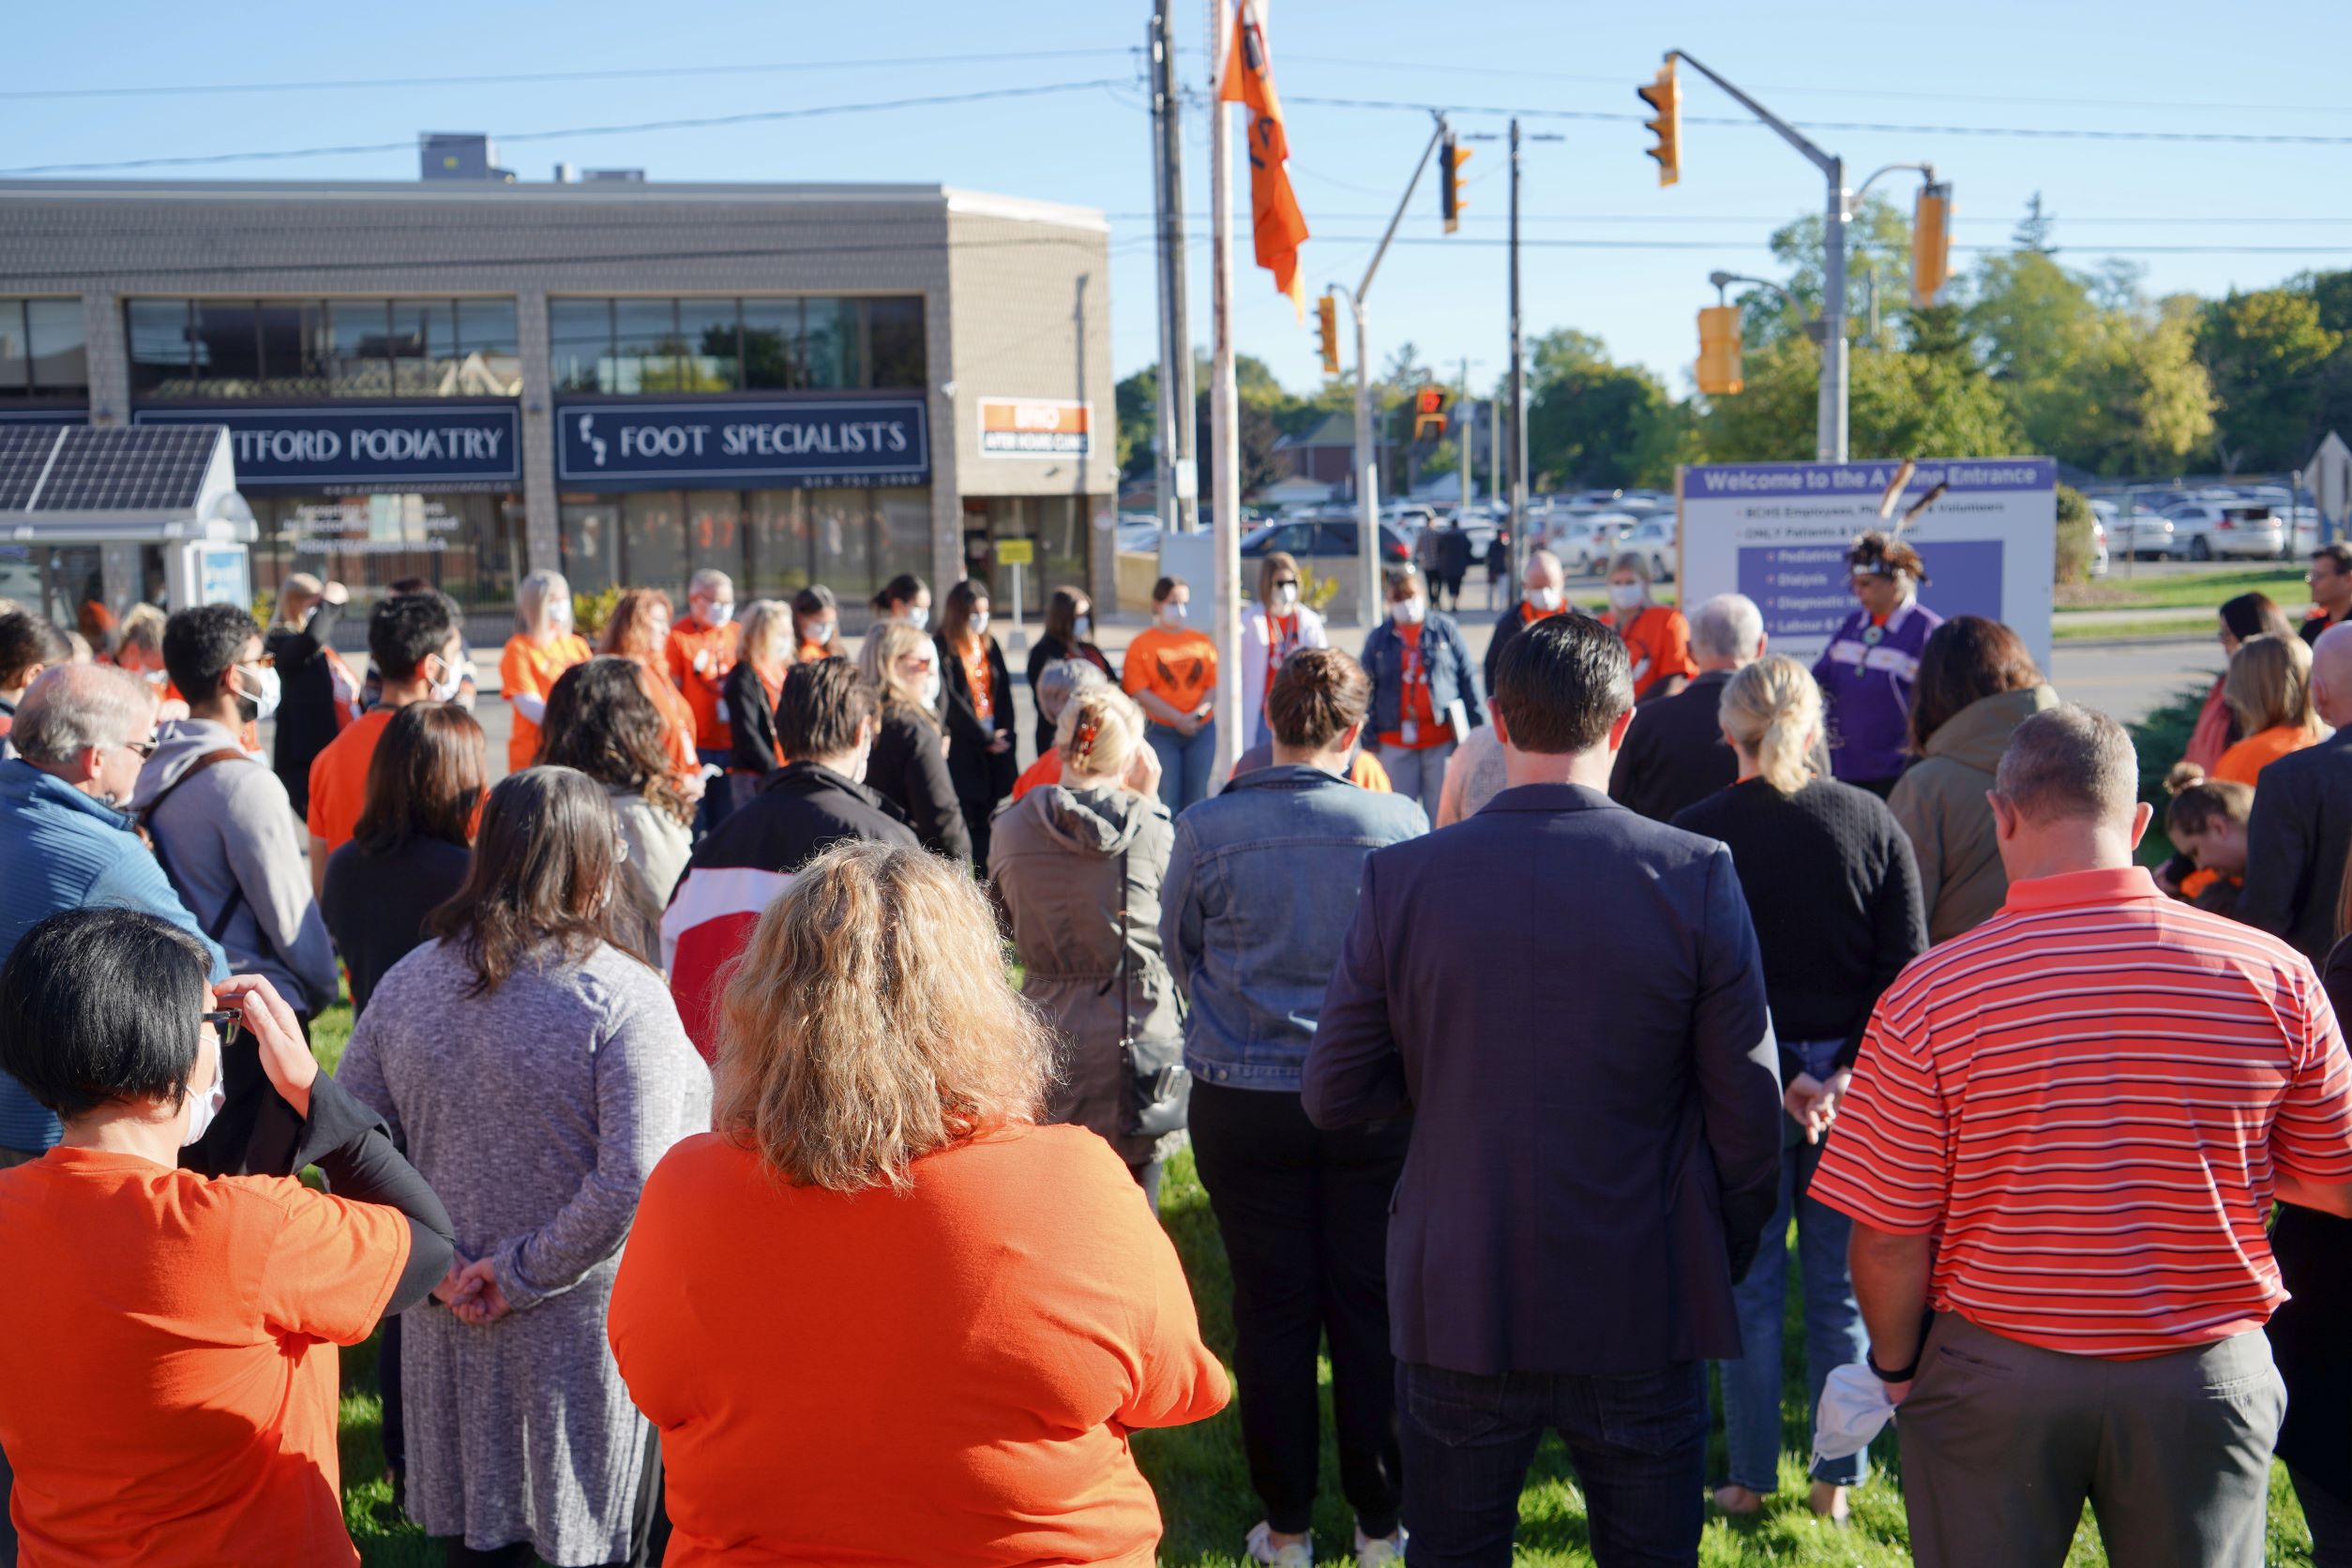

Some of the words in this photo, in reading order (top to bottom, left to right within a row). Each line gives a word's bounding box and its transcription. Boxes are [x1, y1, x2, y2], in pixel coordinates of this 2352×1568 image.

[351, 428, 504, 460] PODIATRY
[620, 425, 712, 457] FOOT
[722, 422, 908, 455] SPECIALISTS
[1704, 471, 1802, 490] Welcome
[1806, 470, 1829, 488] to
[1832, 469, 1866, 488] the
[1870, 468, 1886, 486] A
[1890, 468, 1945, 487] ing
[1948, 467, 2037, 485] Entrance
[1785, 527, 1835, 538] Patients
[1777, 549, 1842, 563] Pediatrics
[1777, 572, 1827, 587] Dialysis
[1777, 596, 1845, 611] Diagnostic
[1777, 618, 1821, 632] Labour
